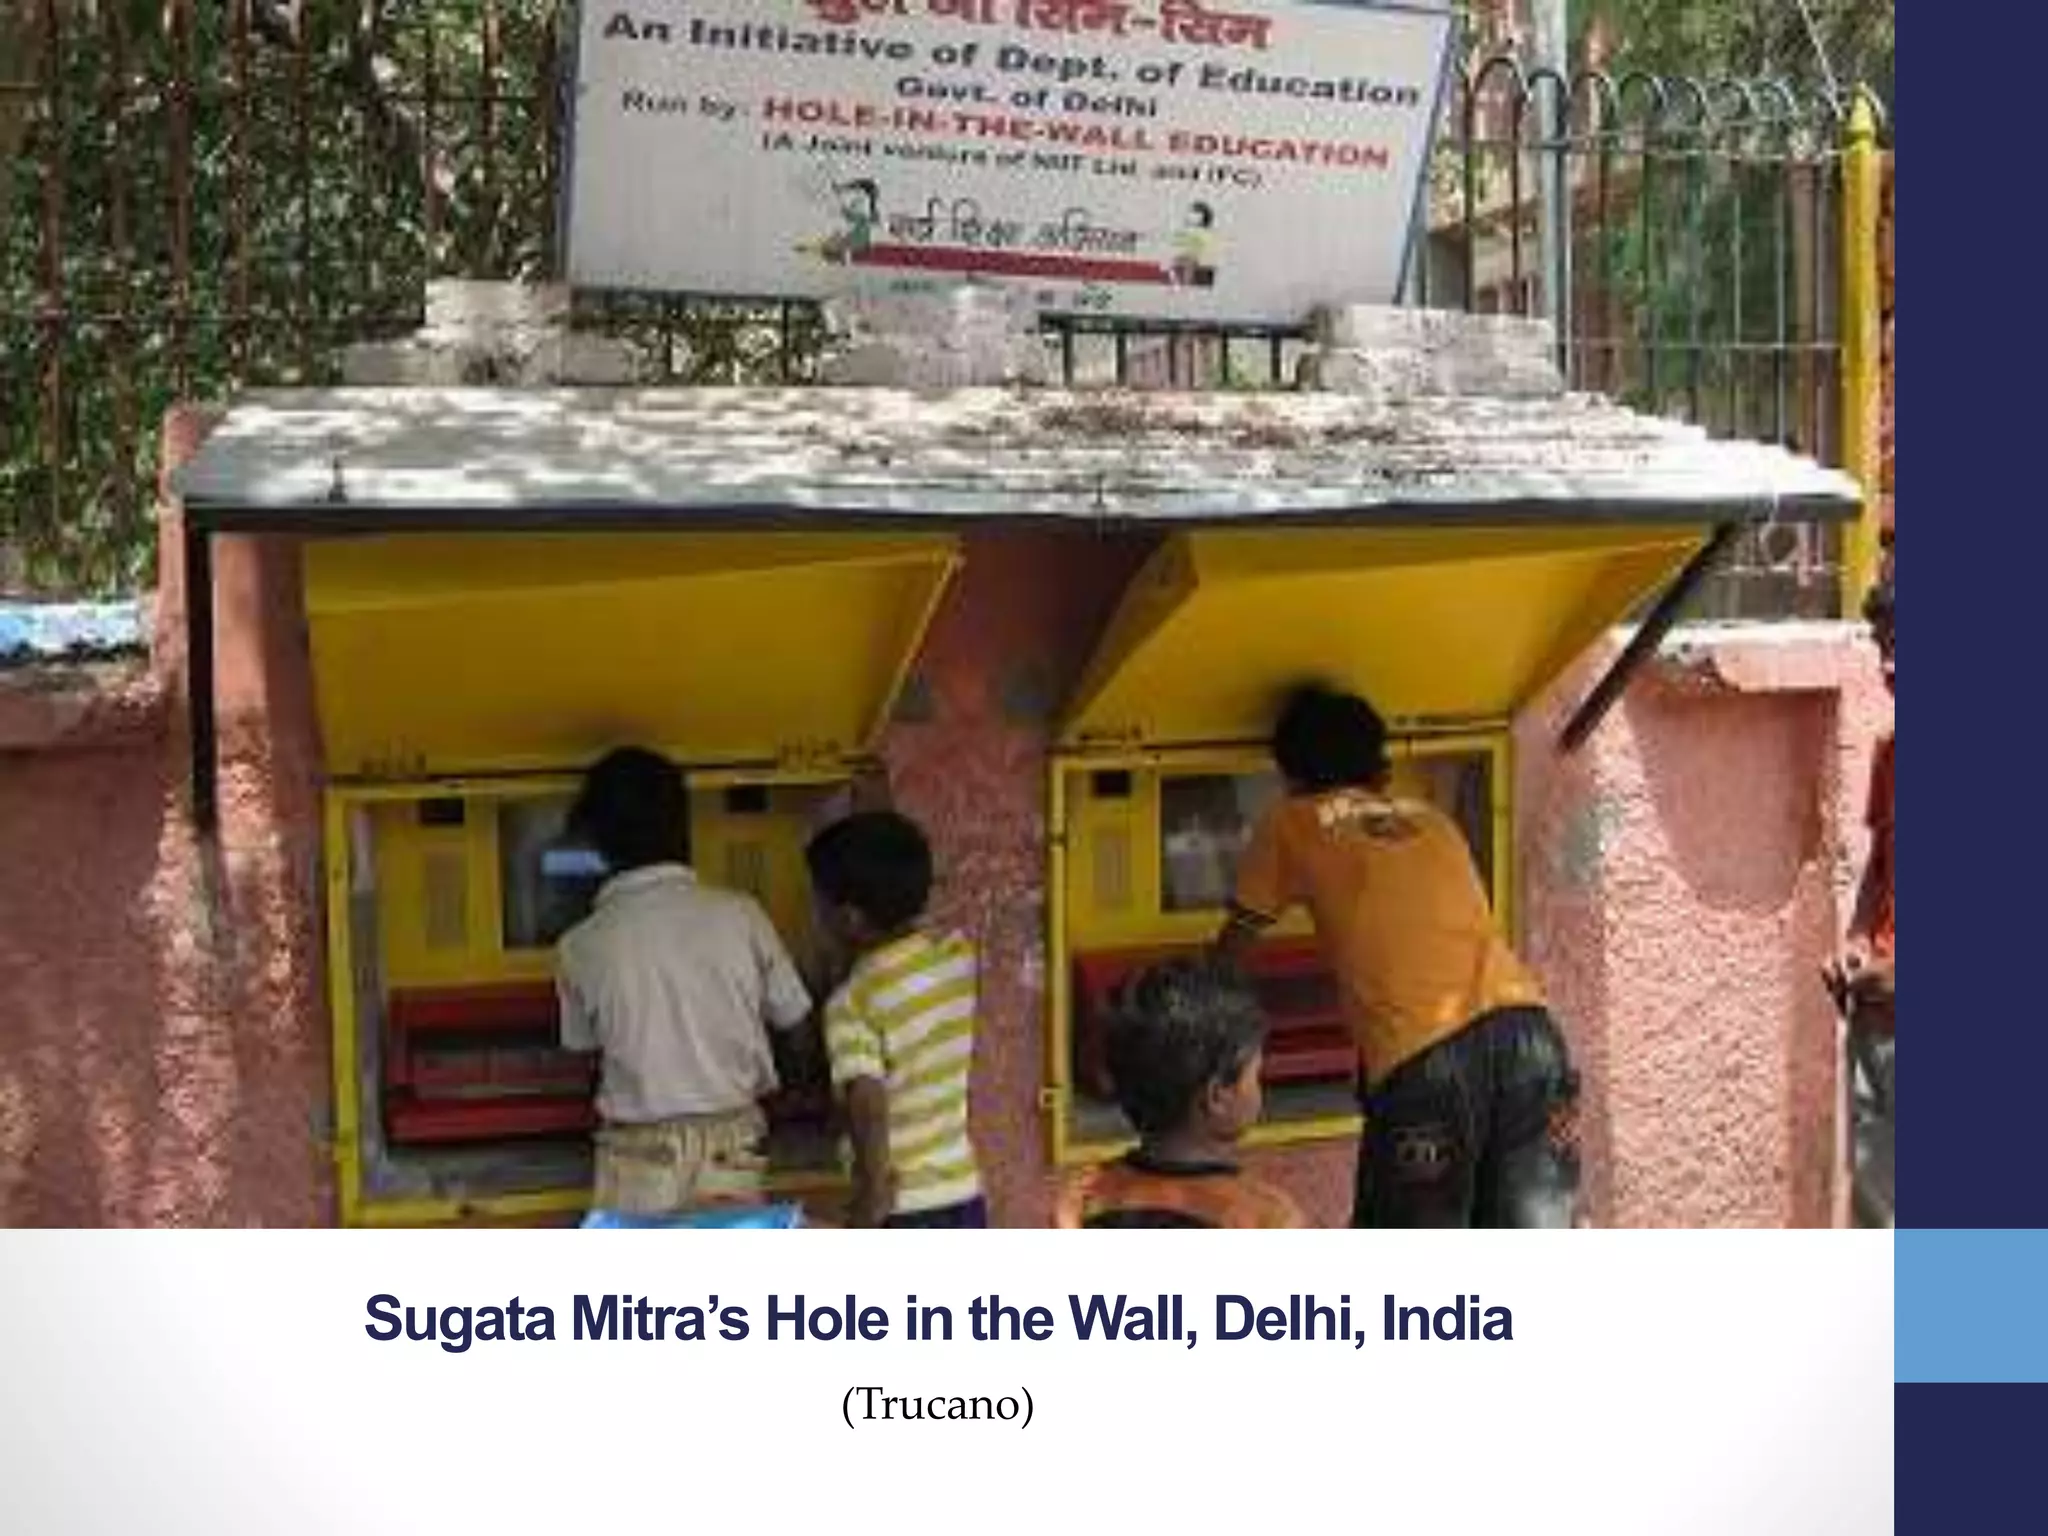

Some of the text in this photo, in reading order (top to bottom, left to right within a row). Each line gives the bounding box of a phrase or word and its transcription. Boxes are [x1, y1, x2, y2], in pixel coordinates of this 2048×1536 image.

[604, 13, 1421, 107] An Initiative of Dept. of Education
[622, 89, 687, 115] Run
[762, 97, 1154, 151] HOLE-IN-THE-WALL
[1169, 129, 1389, 168] EDUCATION
[1010, 90, 1047, 110] of
[1063, 91, 1155, 117] Delhi
[802, 133, 872, 157] Joint
